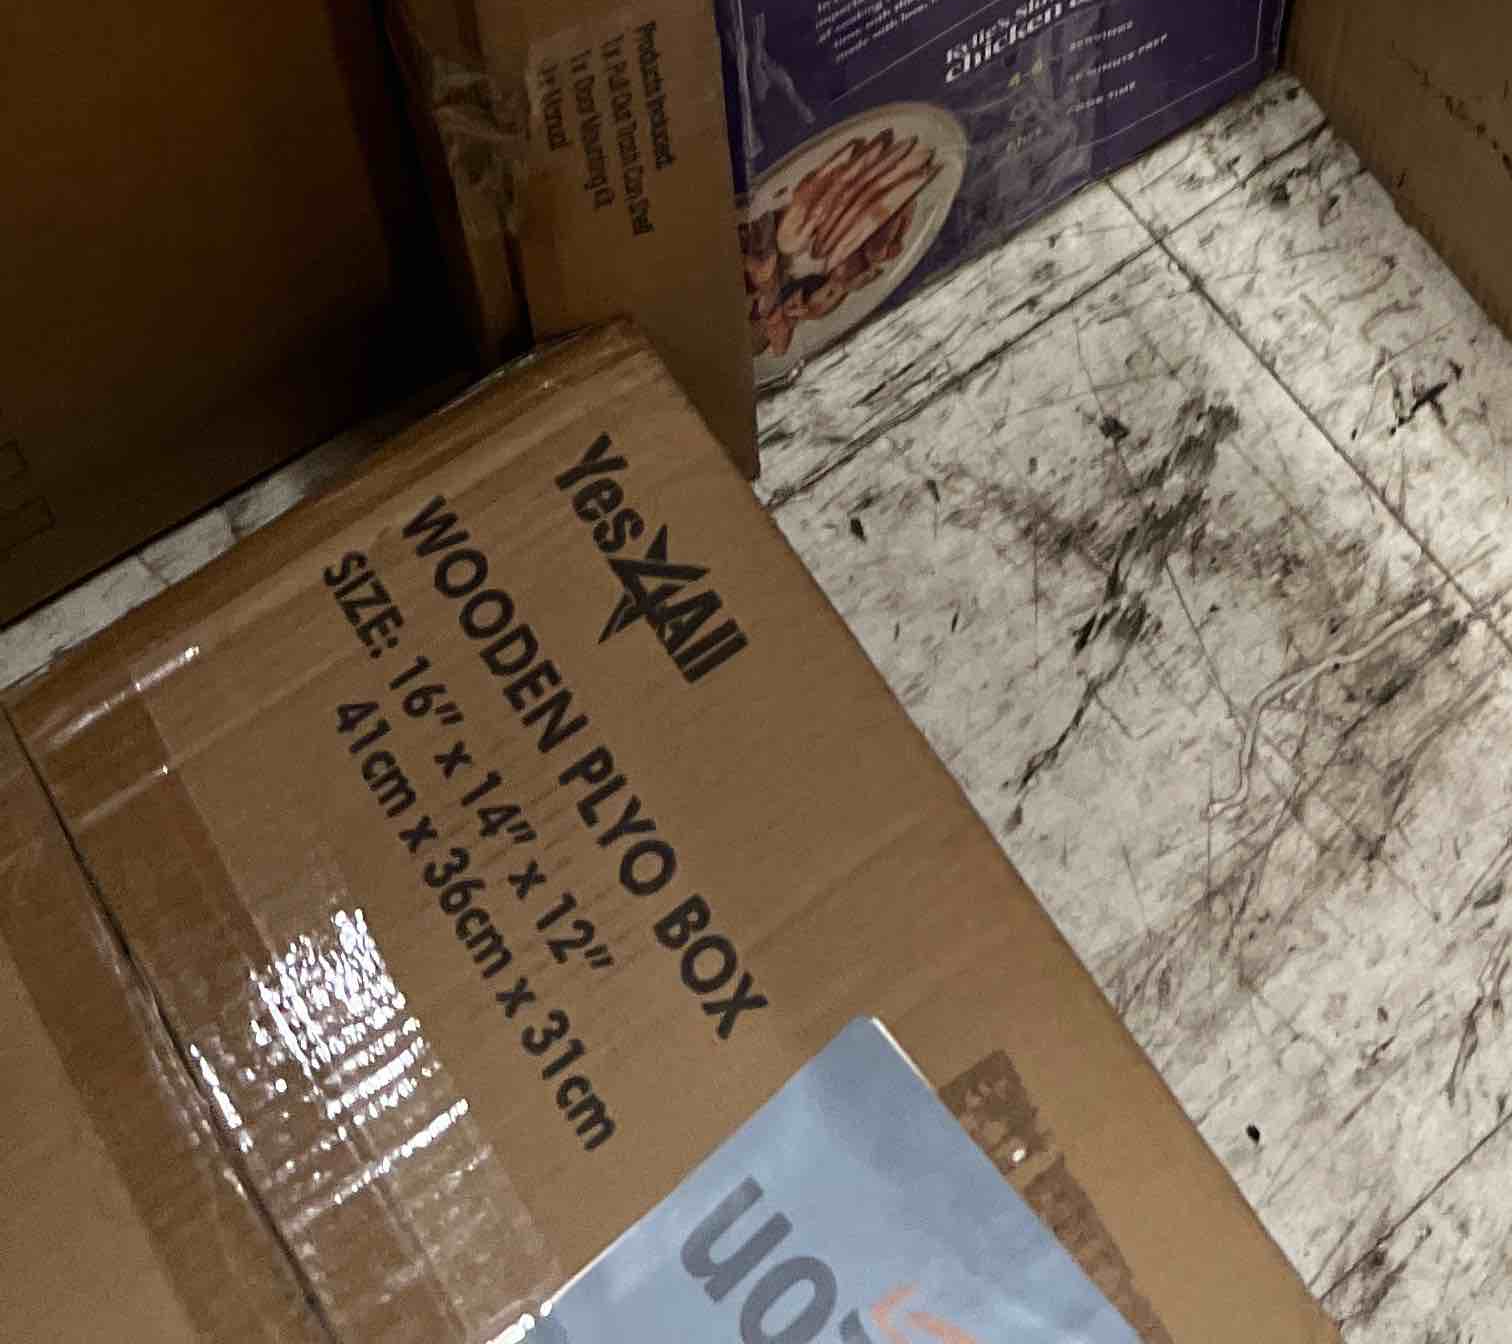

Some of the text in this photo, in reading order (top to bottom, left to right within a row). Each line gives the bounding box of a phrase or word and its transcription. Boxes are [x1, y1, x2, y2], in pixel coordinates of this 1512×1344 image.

[322, 548, 408, 661] SIZE:
[436, 740, 471, 777] x
[508, 861, 547, 900] x
[334, 699, 617, 1156] 41cm x 36cm x 31cm
[401, 494, 769, 1041] WOODEN PLYO BOX
